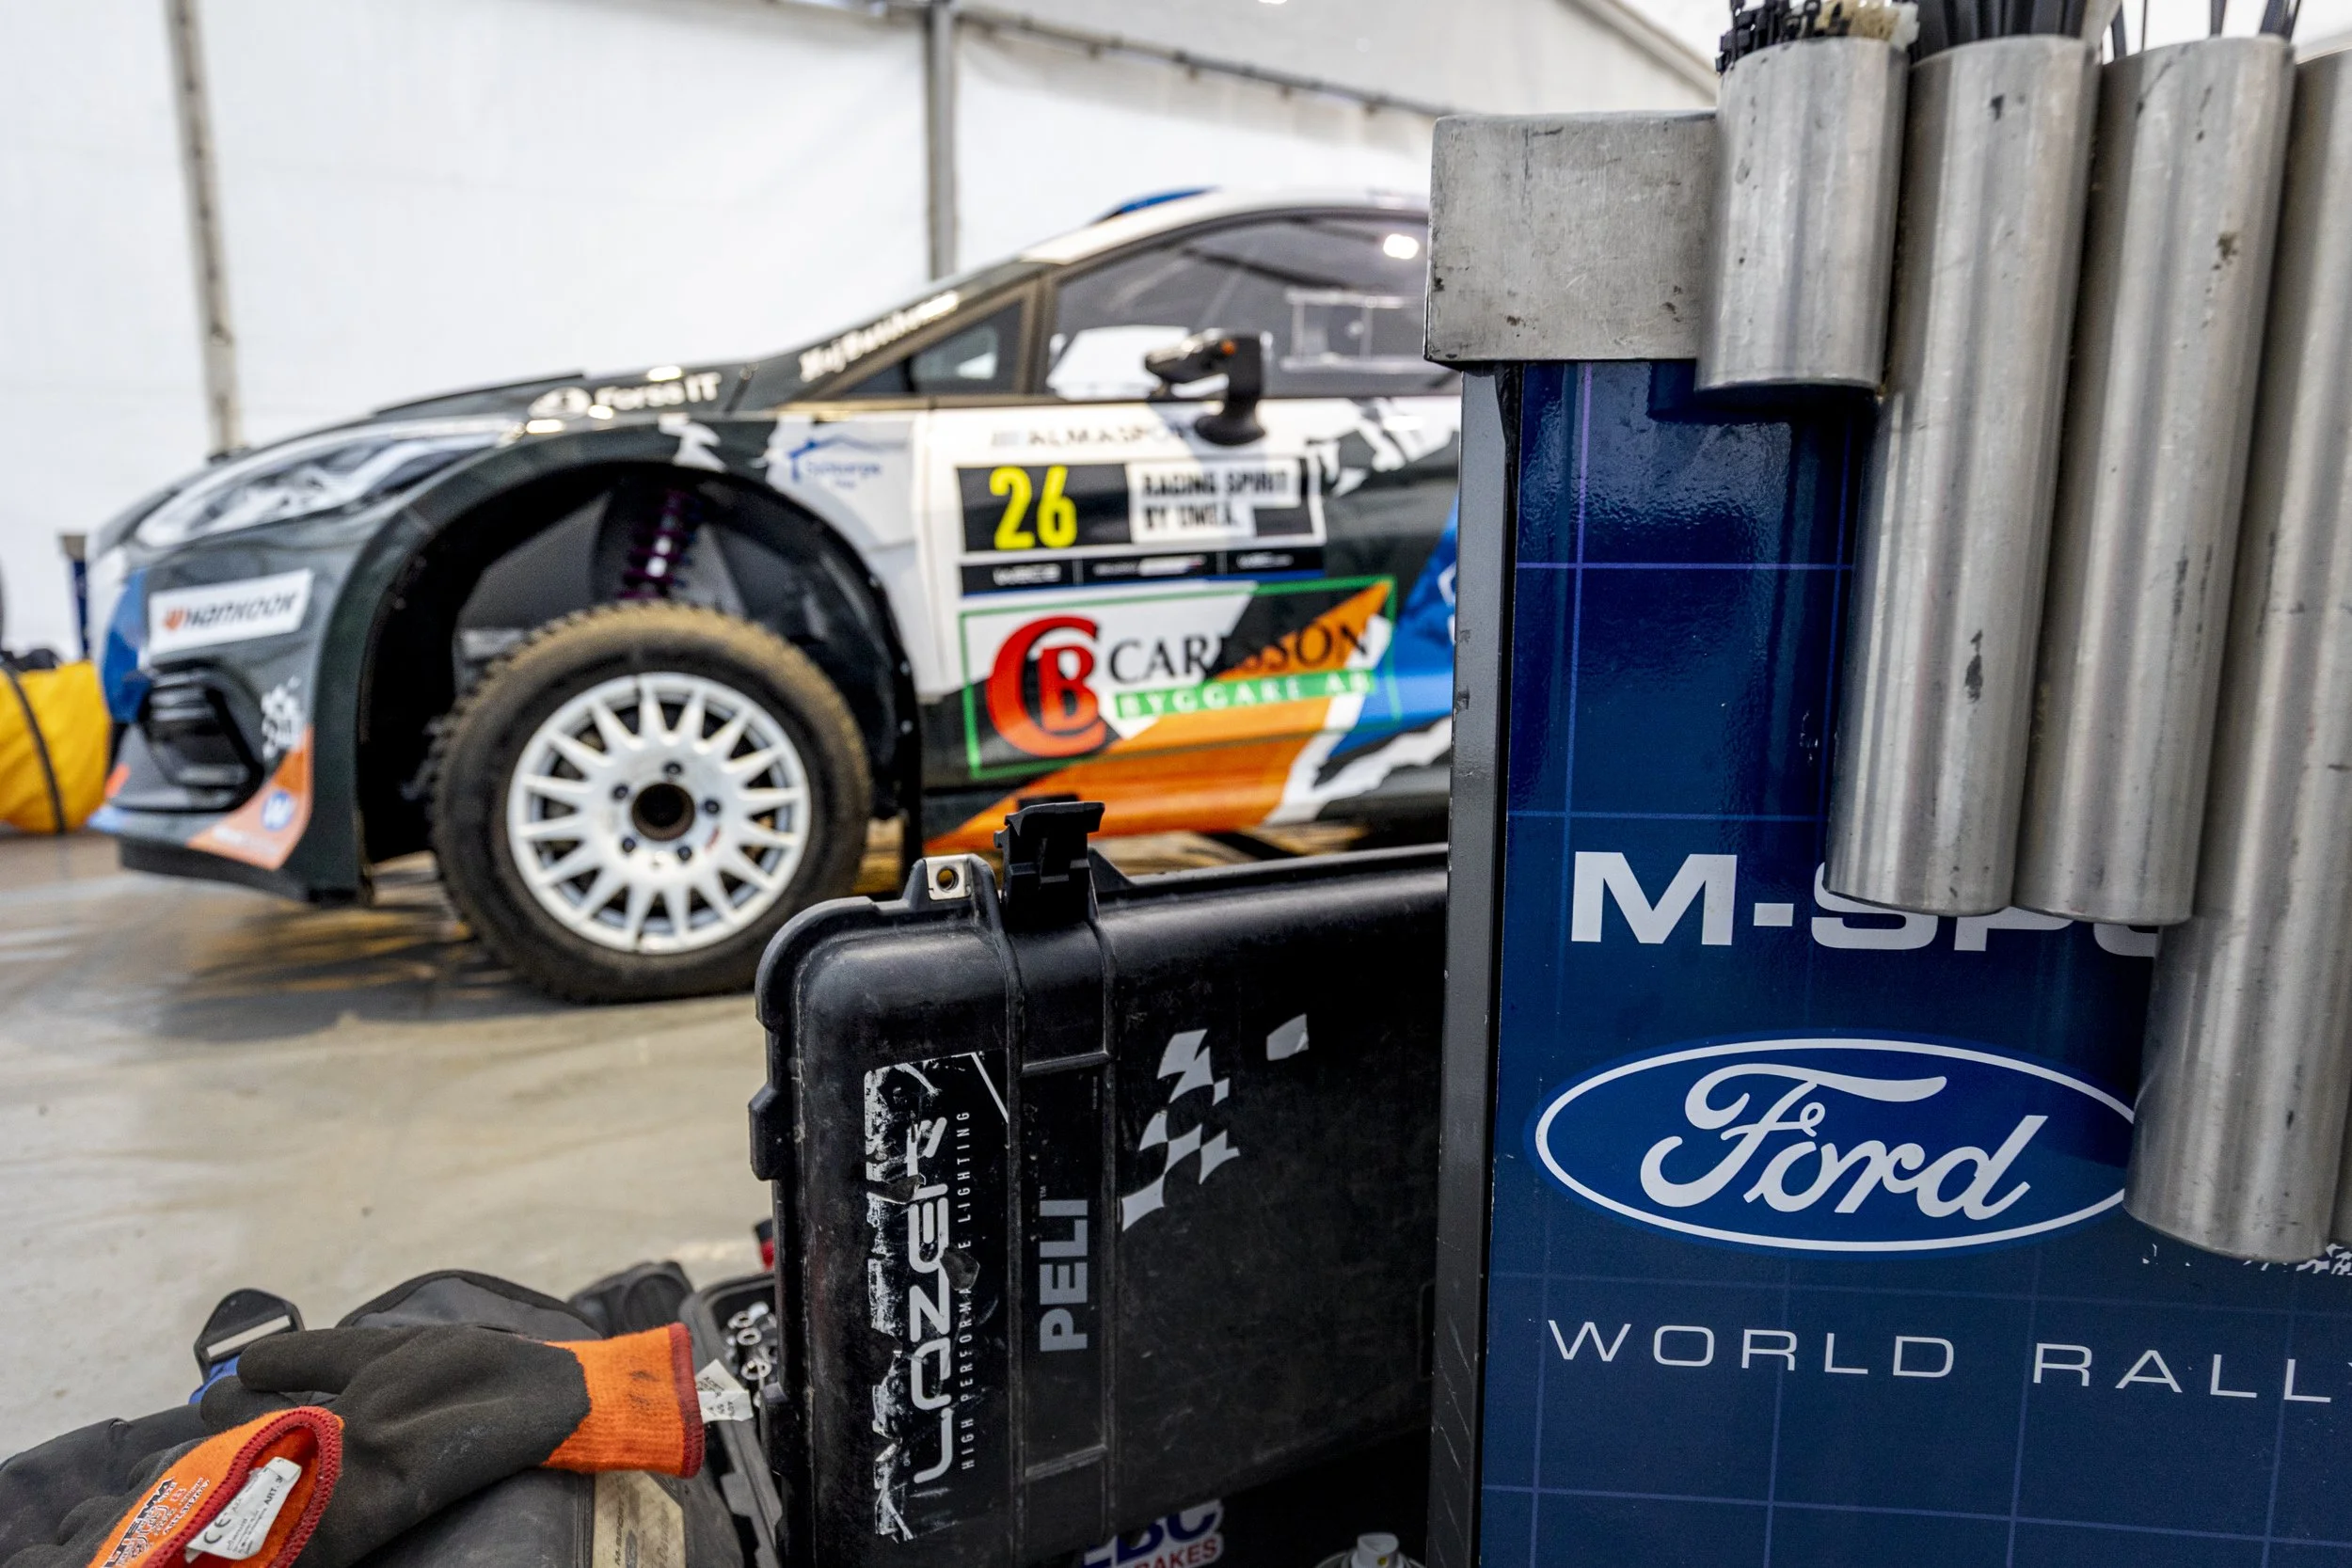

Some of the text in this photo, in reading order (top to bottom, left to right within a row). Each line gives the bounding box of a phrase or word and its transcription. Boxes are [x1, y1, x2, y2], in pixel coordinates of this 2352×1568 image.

[989, 465, 1078, 549] 26
[1226, 467, 1290, 495] SPIRIT
[1109, 622, 1372, 684] CARSSON
[1120, 668, 1373, 719] BYGGARE AB
[1641, 1063, 2049, 1220] Ford
[956, 1111, 975, 1470] HIGH PERFORMAE LIGHTING
[1039, 1198, 1089, 1353] PELI
[1548, 1319, 2352, 1404] WORLD RALL
